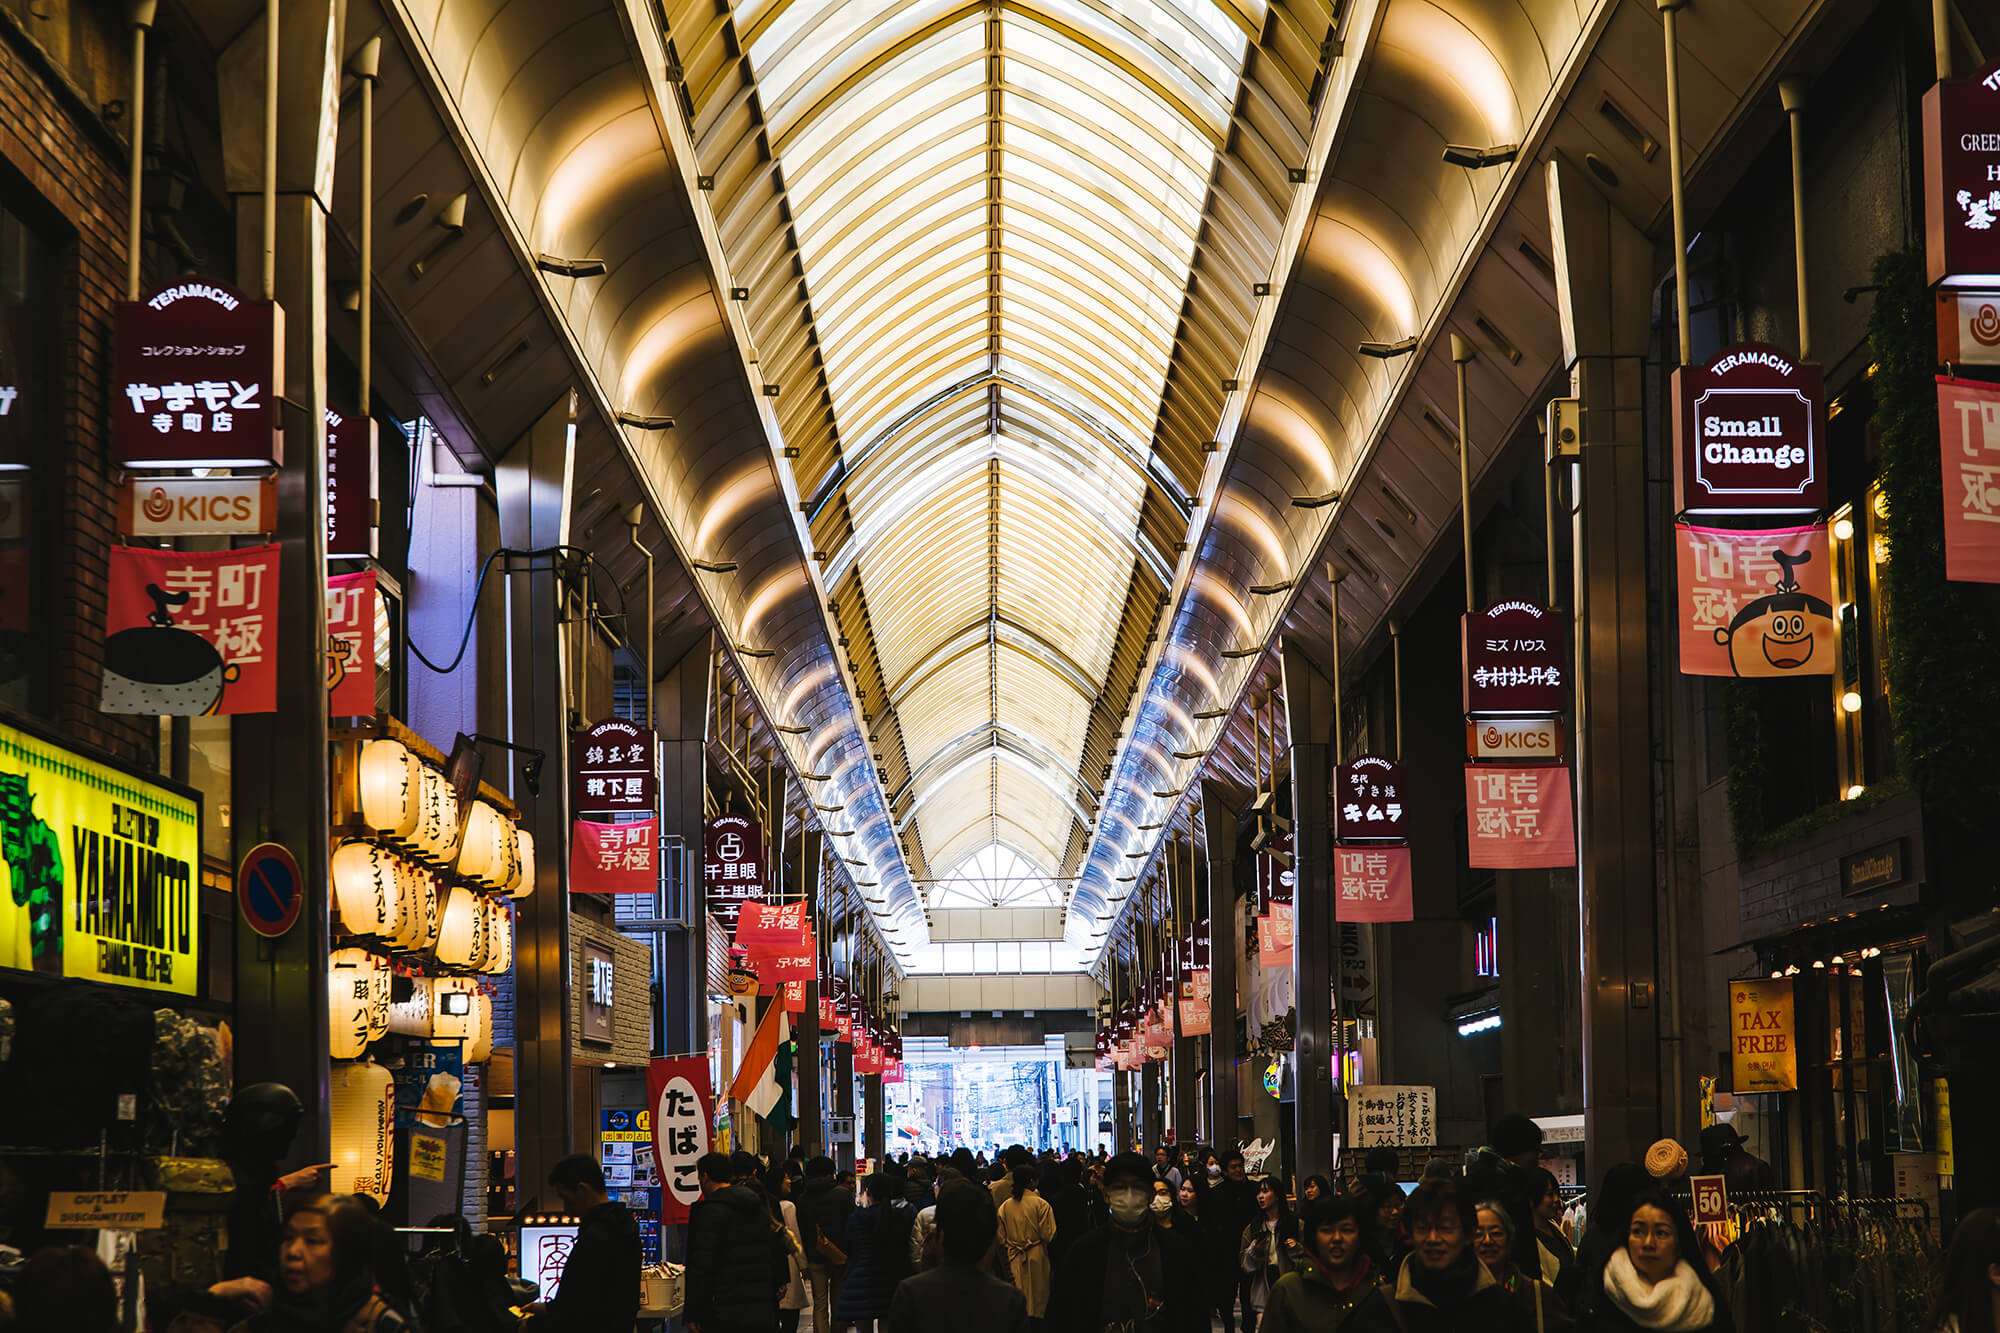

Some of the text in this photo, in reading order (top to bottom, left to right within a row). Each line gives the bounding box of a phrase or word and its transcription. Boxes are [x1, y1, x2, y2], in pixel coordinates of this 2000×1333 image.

[1961, 134, 2000, 151] GREE
[148, 284, 239, 311] TERAMACHI
[1711, 352, 1793, 376] TERAMACHI
[125, 380, 261, 413] やまもと
[152, 412, 233, 433] 寺町店
[1704, 417, 1782, 437] Small
[1704, 443, 1805, 468] Change
[178, 495, 252, 521] KICS
[1487, 601, 1543, 619] TERAMACHI
[1486, 639, 1546, 651] ミズ ハウス
[591, 723, 638, 737] TERAMACHI
[1505, 732, 1550, 749] KICS
[1352, 757, 1393, 771] TERAMACHI
[587, 778, 643, 796] 靴下屋
[713, 817, 749, 829] TERAMACHI
[1343, 803, 1403, 823] キムラ
[600, 826, 652, 849] 寺町
[597, 848, 650, 870] 京極
[706, 863, 757, 880] 千里眼
[72, 825, 190, 955] YAMAMOTO
[1739, 1010, 1781, 1030] TAX
[1737, 1034, 1787, 1054] FREE
[1376, 1099, 1386, 1146] 普通一人
[1385, 1101, 1395, 1146] ロース一人
[666, 1089, 700, 1192] たばこ
[1699, 1190, 1722, 1214] 50
